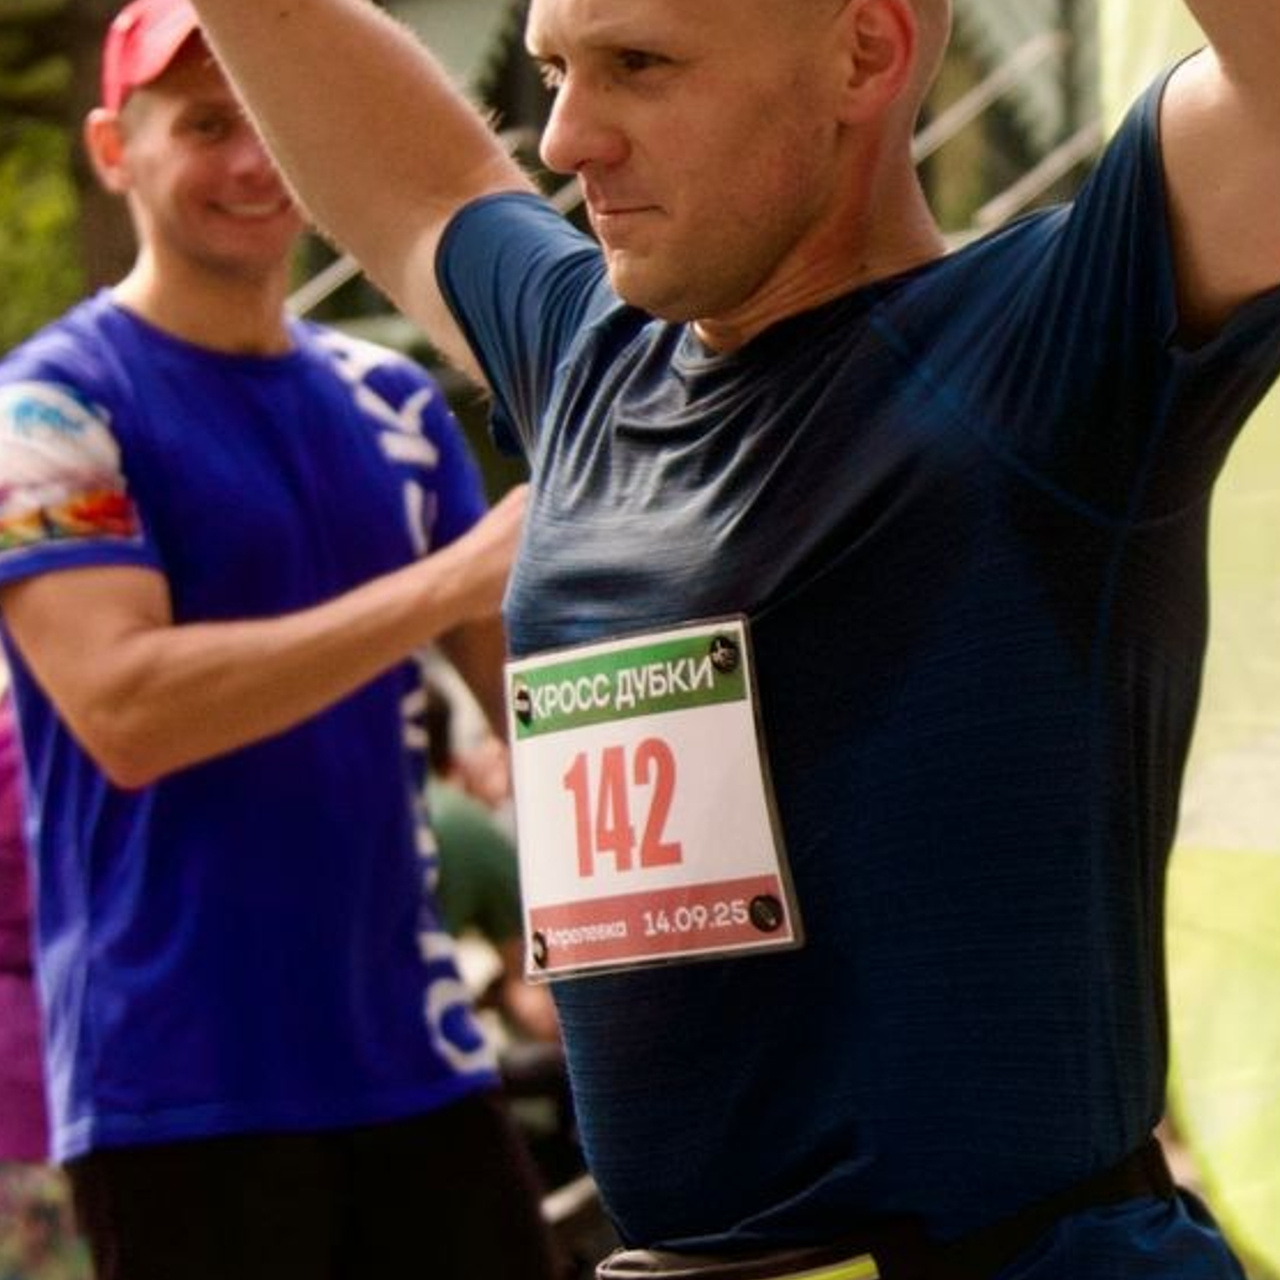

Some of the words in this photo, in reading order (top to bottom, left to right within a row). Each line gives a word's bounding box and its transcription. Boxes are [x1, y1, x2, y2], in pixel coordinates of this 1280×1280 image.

[531, 673, 612, 719] КРОСС
[616, 654, 715, 711] ДУБКИ
[563, 737, 682, 877] 142
[643, 899, 749, 937] 14.09.25
